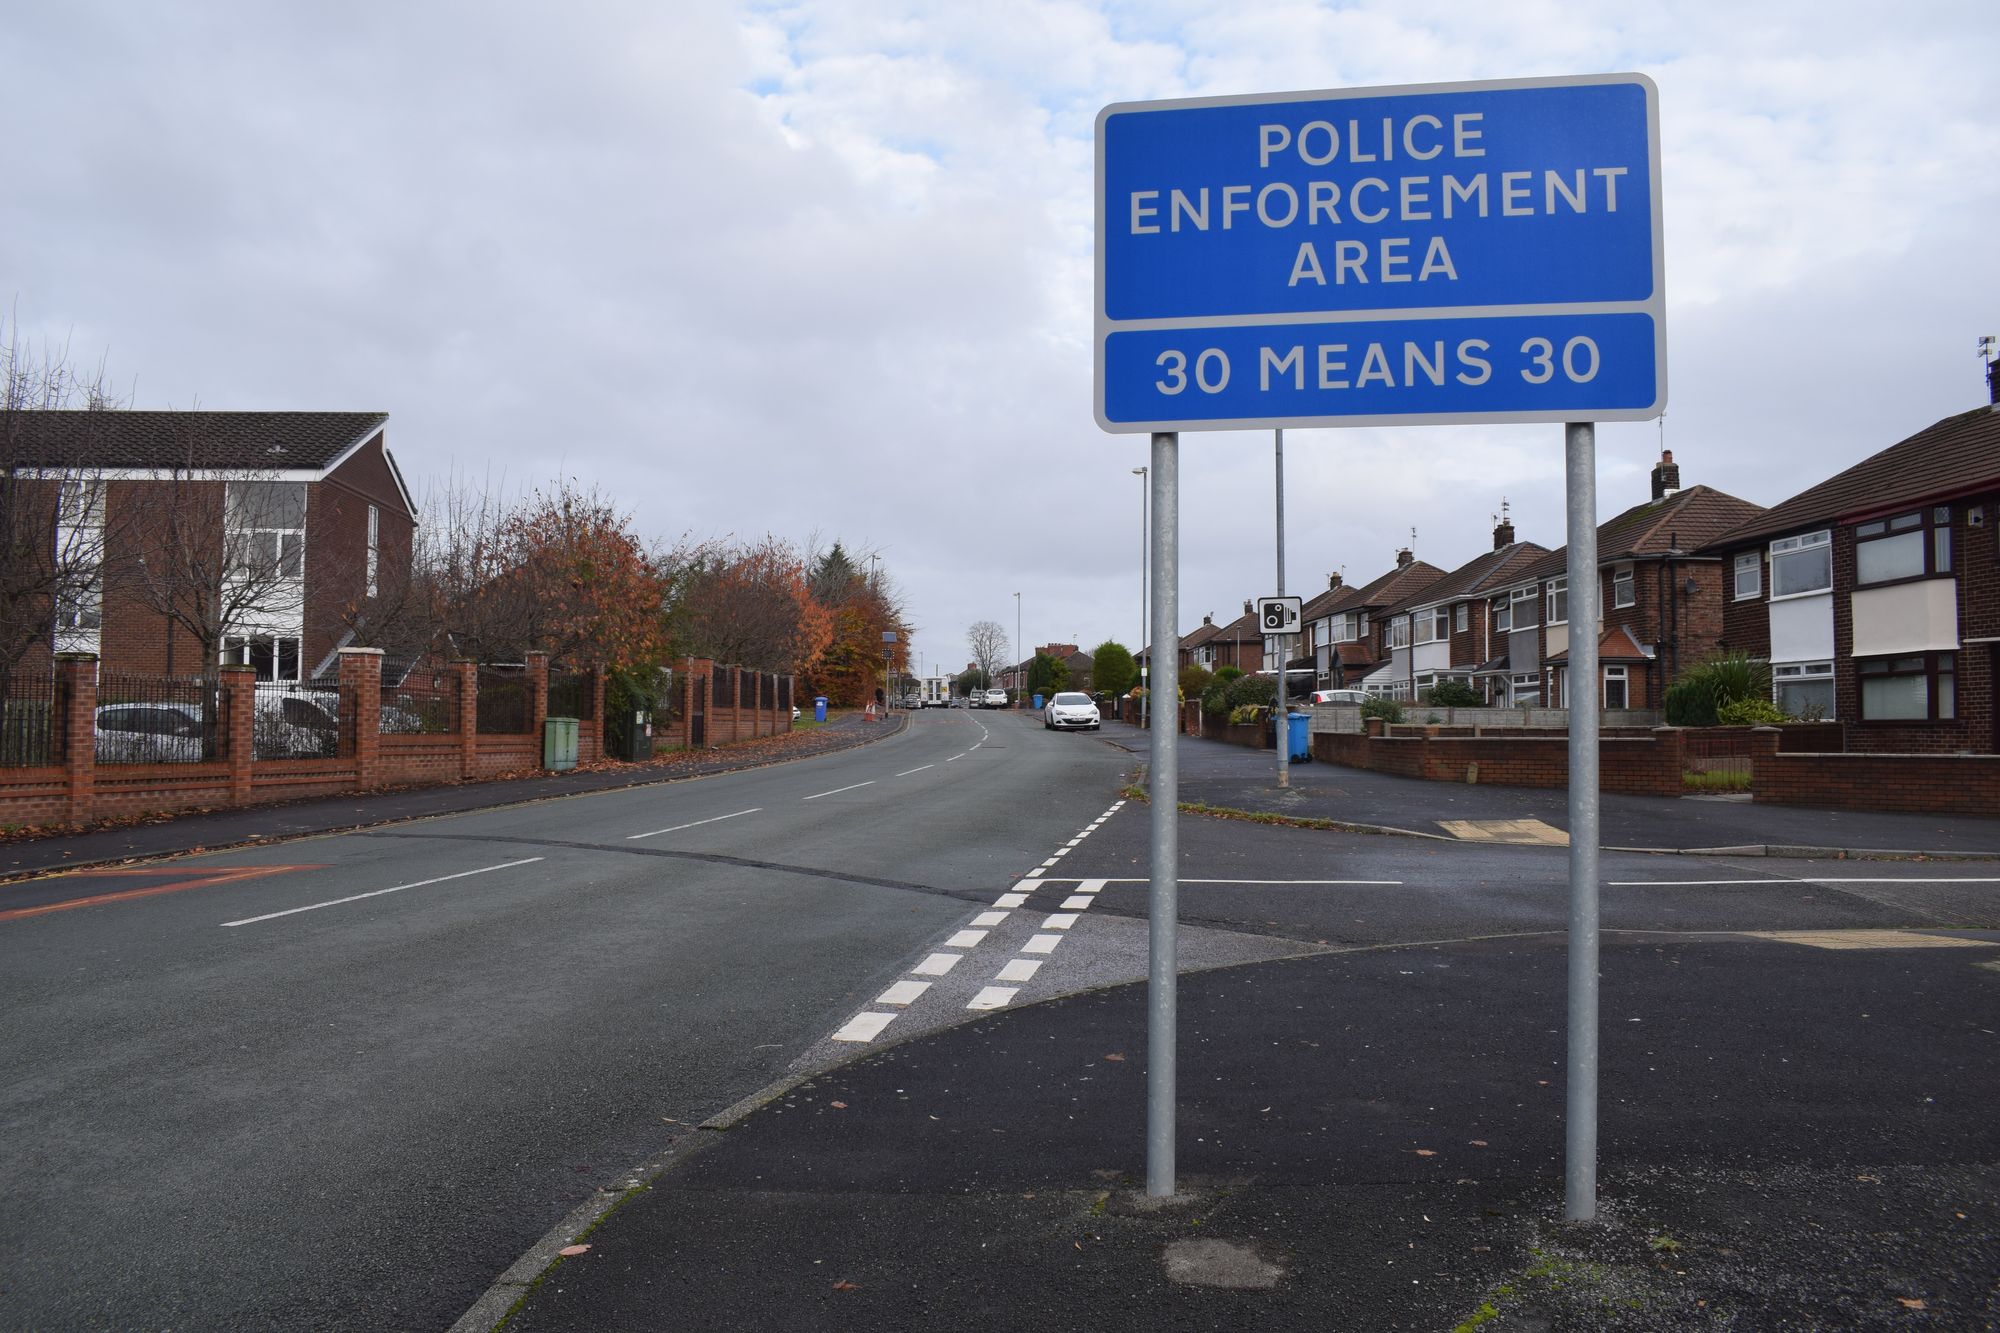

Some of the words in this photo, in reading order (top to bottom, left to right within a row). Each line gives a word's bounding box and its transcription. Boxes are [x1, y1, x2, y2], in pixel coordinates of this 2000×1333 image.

[1259, 112, 1486, 168] POLICE
[1130, 166, 1628, 235] ENFORCEMENT
[1287, 236, 1458, 287] AREA
[1155, 347, 1231, 395] 30
[1259, 338, 1492, 391] MEANS
[1520, 335, 1600, 384] 30
